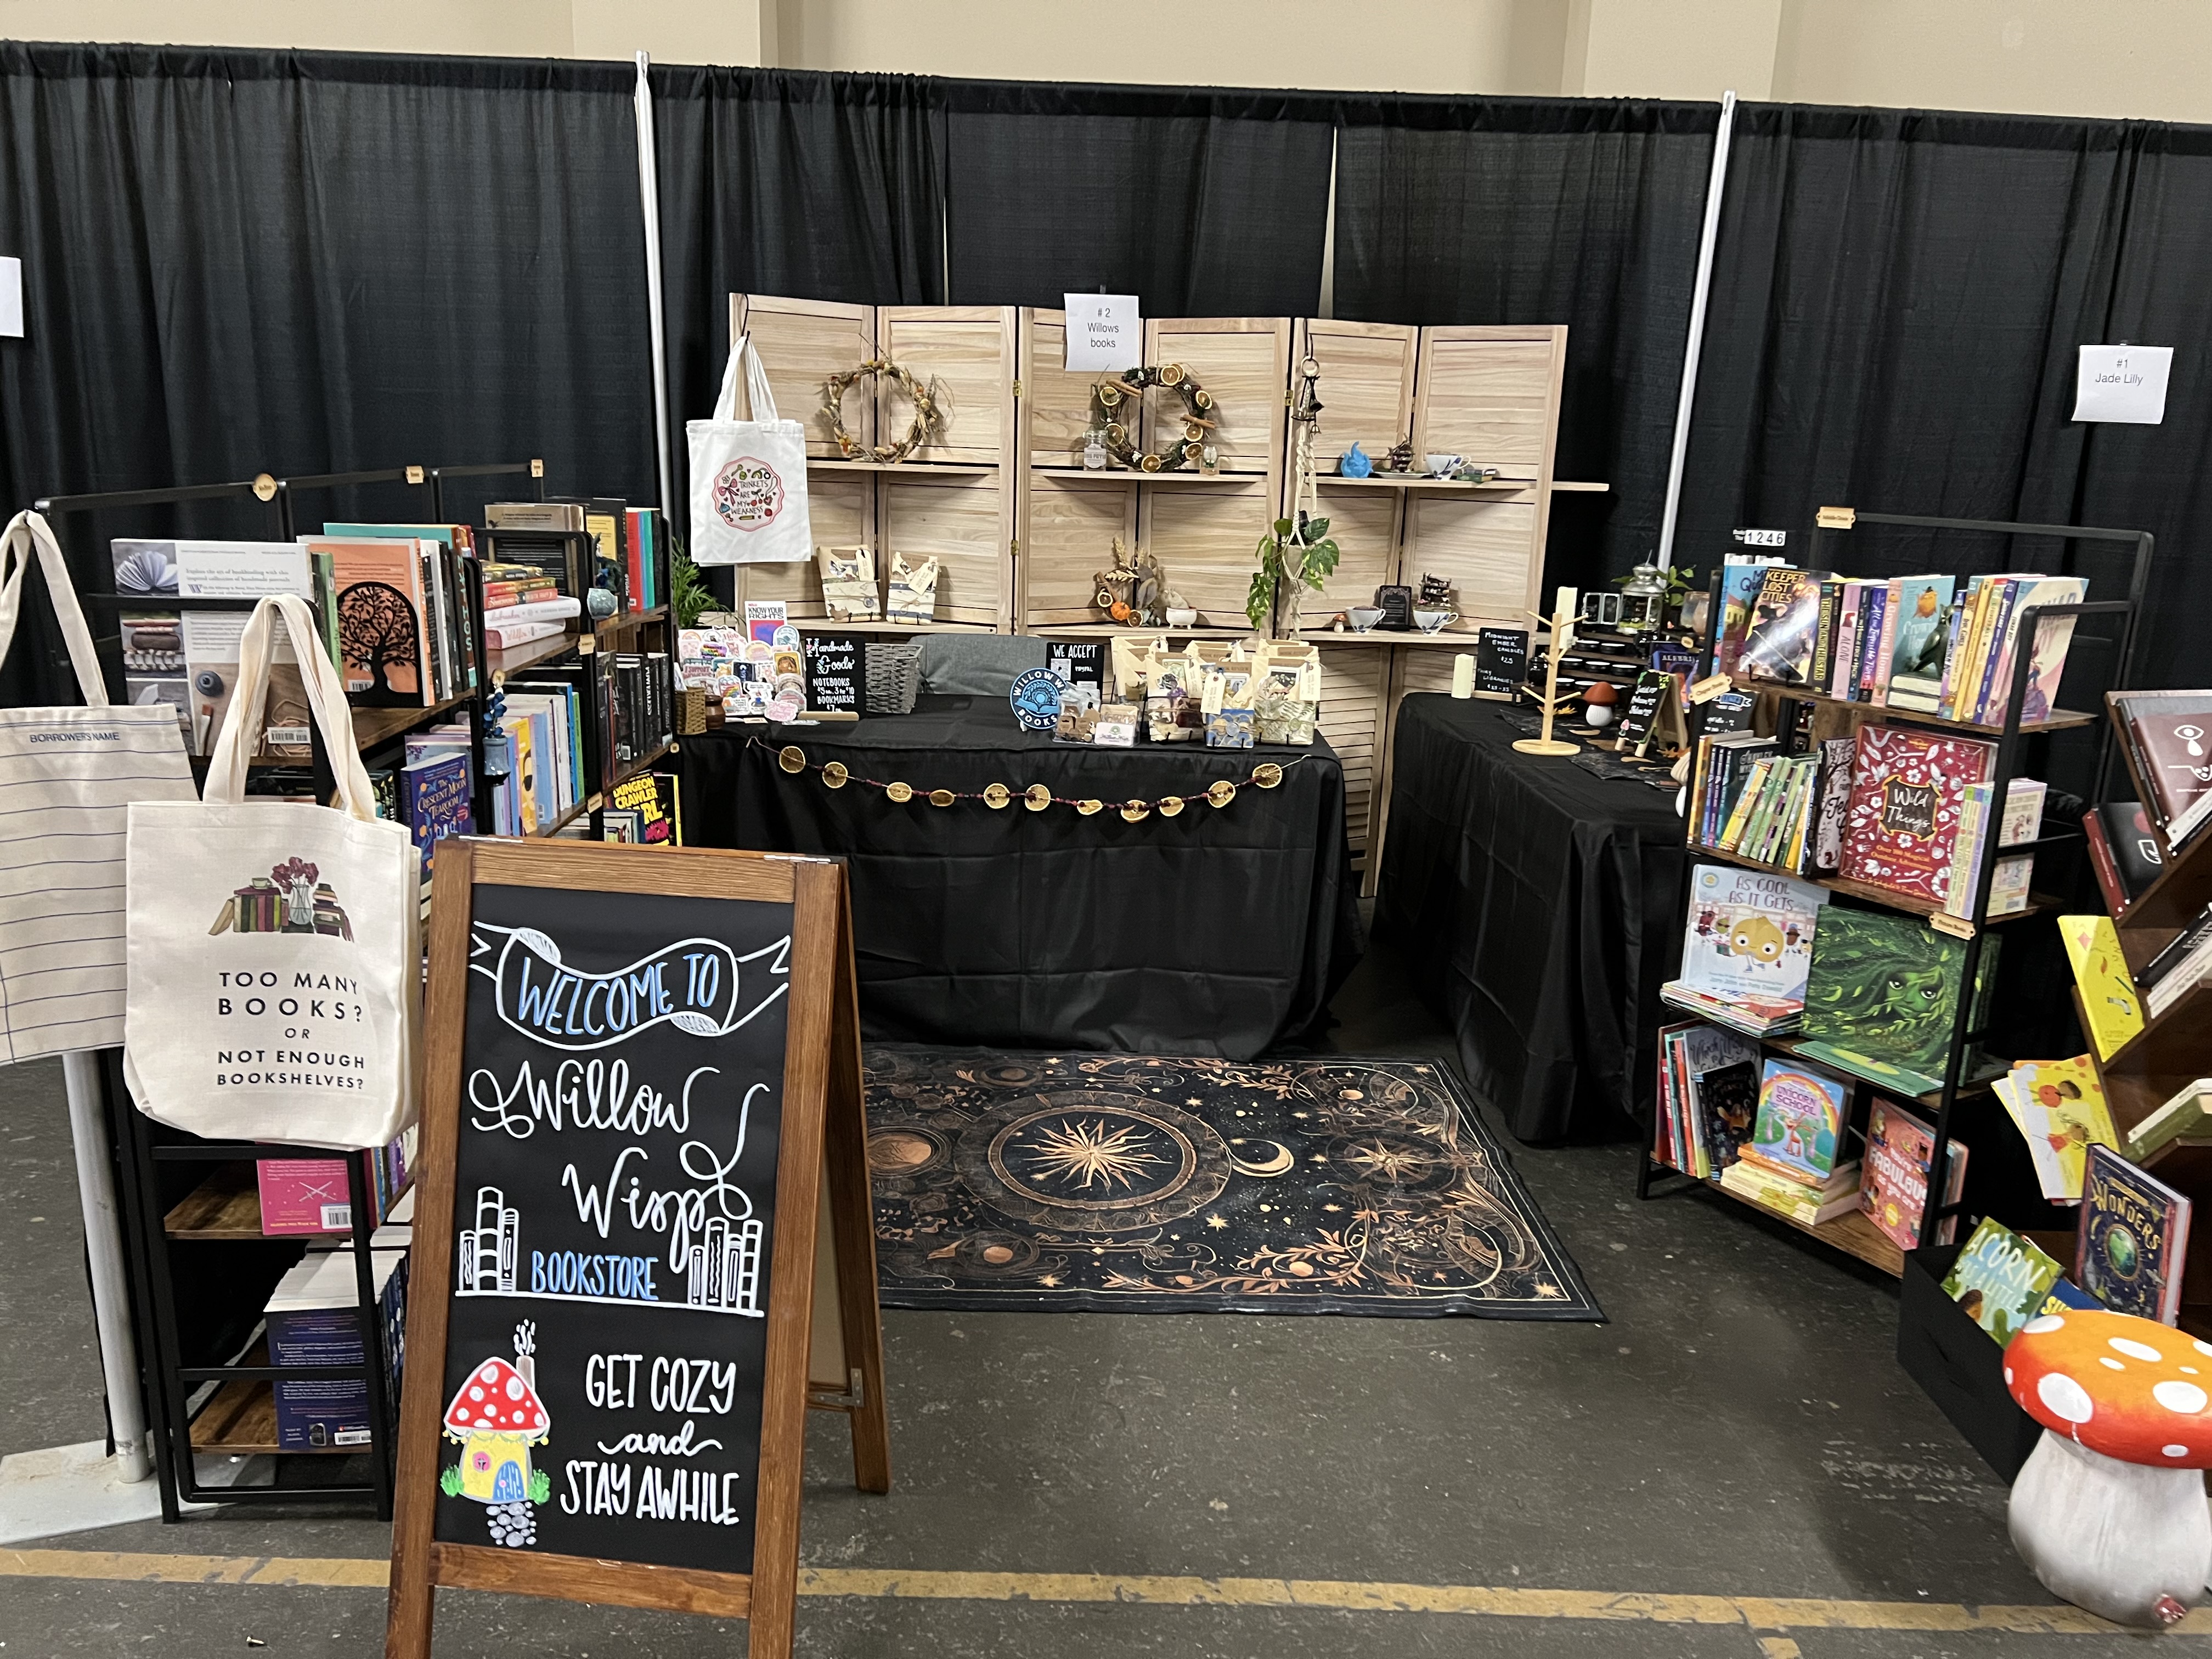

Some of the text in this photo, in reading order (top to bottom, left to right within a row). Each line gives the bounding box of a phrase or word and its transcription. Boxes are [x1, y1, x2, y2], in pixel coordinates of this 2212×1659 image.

[1105, 308, 1110, 318] 2
[1087, 322, 1119, 333] Willows
[1091, 337, 1116, 348] books
[2117, 358, 2128, 368] #1
[2095, 373, 2143, 386] Jade Lilly
[739, 480, 768, 488] TRINKETS
[1763, 582, 1791, 593] LOST
[1765, 572, 1806, 584] KEEPER
[1760, 591, 1793, 604] CITIES
[806, 638, 854, 657] Handmade
[1814, 598, 1832, 680] THE SUN AND THE STAR
[1839, 635, 1852, 663] ALONE
[1876, 605, 1896, 681] Growing Home
[1053, 645, 1097, 658] WE ACCEPT
[816, 655, 855, 674] Goods
[812, 678, 850, 687] NOTEBOOKS
[1013, 670, 1054, 696] WILLOW
[817, 695, 855, 704] BOOKMARKS
[1018, 709, 1058, 726] BOOKS
[448, 777, 467, 798] MOON
[613, 776, 655, 798] DUNGEON
[1894, 787, 1929, 807] Wild
[615, 787, 658, 810] CRAWLER
[1887, 805, 1931, 832] Things
[1736, 876, 1790, 895] AS COOL
[1729, 890, 1795, 912] AS IT GETS
[219, 972, 357, 995] TOO MANY
[518, 953, 720, 1036] WELCOME TO
[218, 998, 362, 1022] BOOKS?
[285, 1028, 310, 1039] OR
[218, 1051, 364, 1069] NOT ENOUGH
[217, 1073, 363, 1089] BOOKSHELVES?
[468, 1059, 720, 1139] Willow
[1776, 1085, 1815, 1107] UNICORN
[1776, 1094, 1816, 1116] SCHOOL
[2090, 1173, 2162, 1250] WONDERS
[1966, 1227, 2046, 1291] ACORN
[531, 1250, 659, 1300] BOOKSTORE
[585, 1353, 737, 1415] GET COZY
[597, 1420, 724, 1457] and
[560, 1460, 740, 1525] STAY AWHILE
